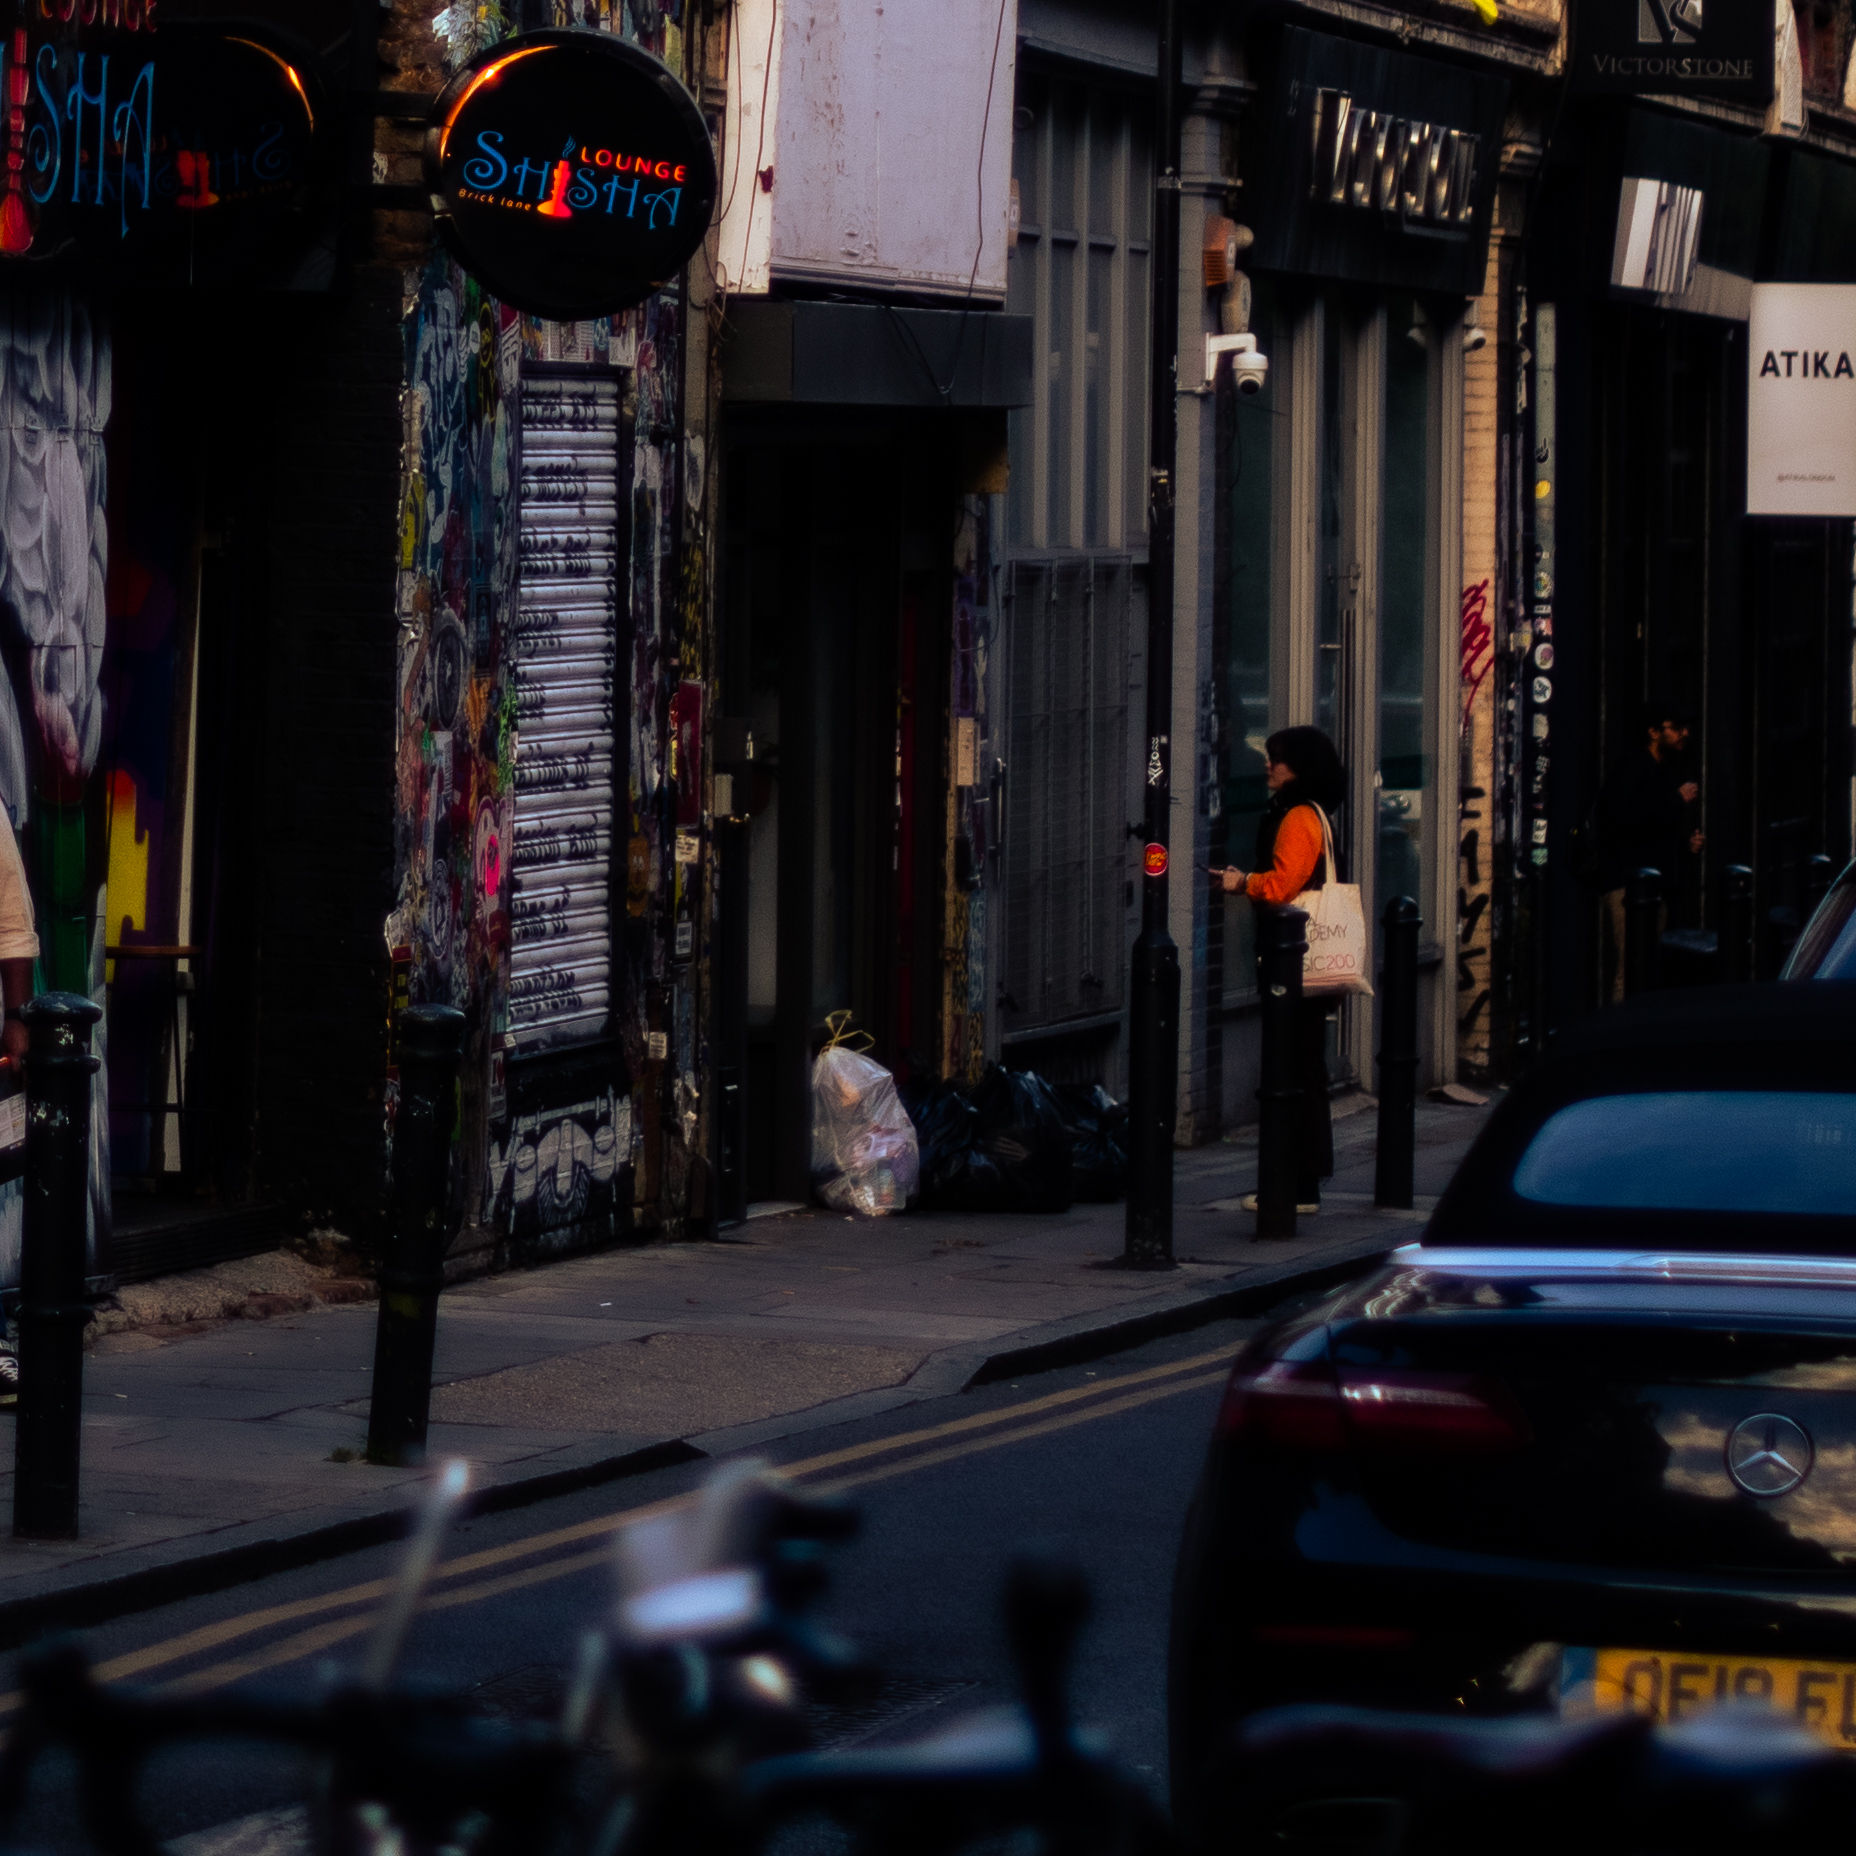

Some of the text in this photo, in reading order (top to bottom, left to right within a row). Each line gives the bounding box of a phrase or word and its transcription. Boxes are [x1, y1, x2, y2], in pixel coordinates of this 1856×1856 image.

[580, 145, 689, 182] LOUNGE
[463, 130, 683, 230] SHISHA
[458, 187, 532, 212] Brick lane
[1760, 350, 1855, 379] ATIKA
[1309, 923, 1349, 944] DEMY
